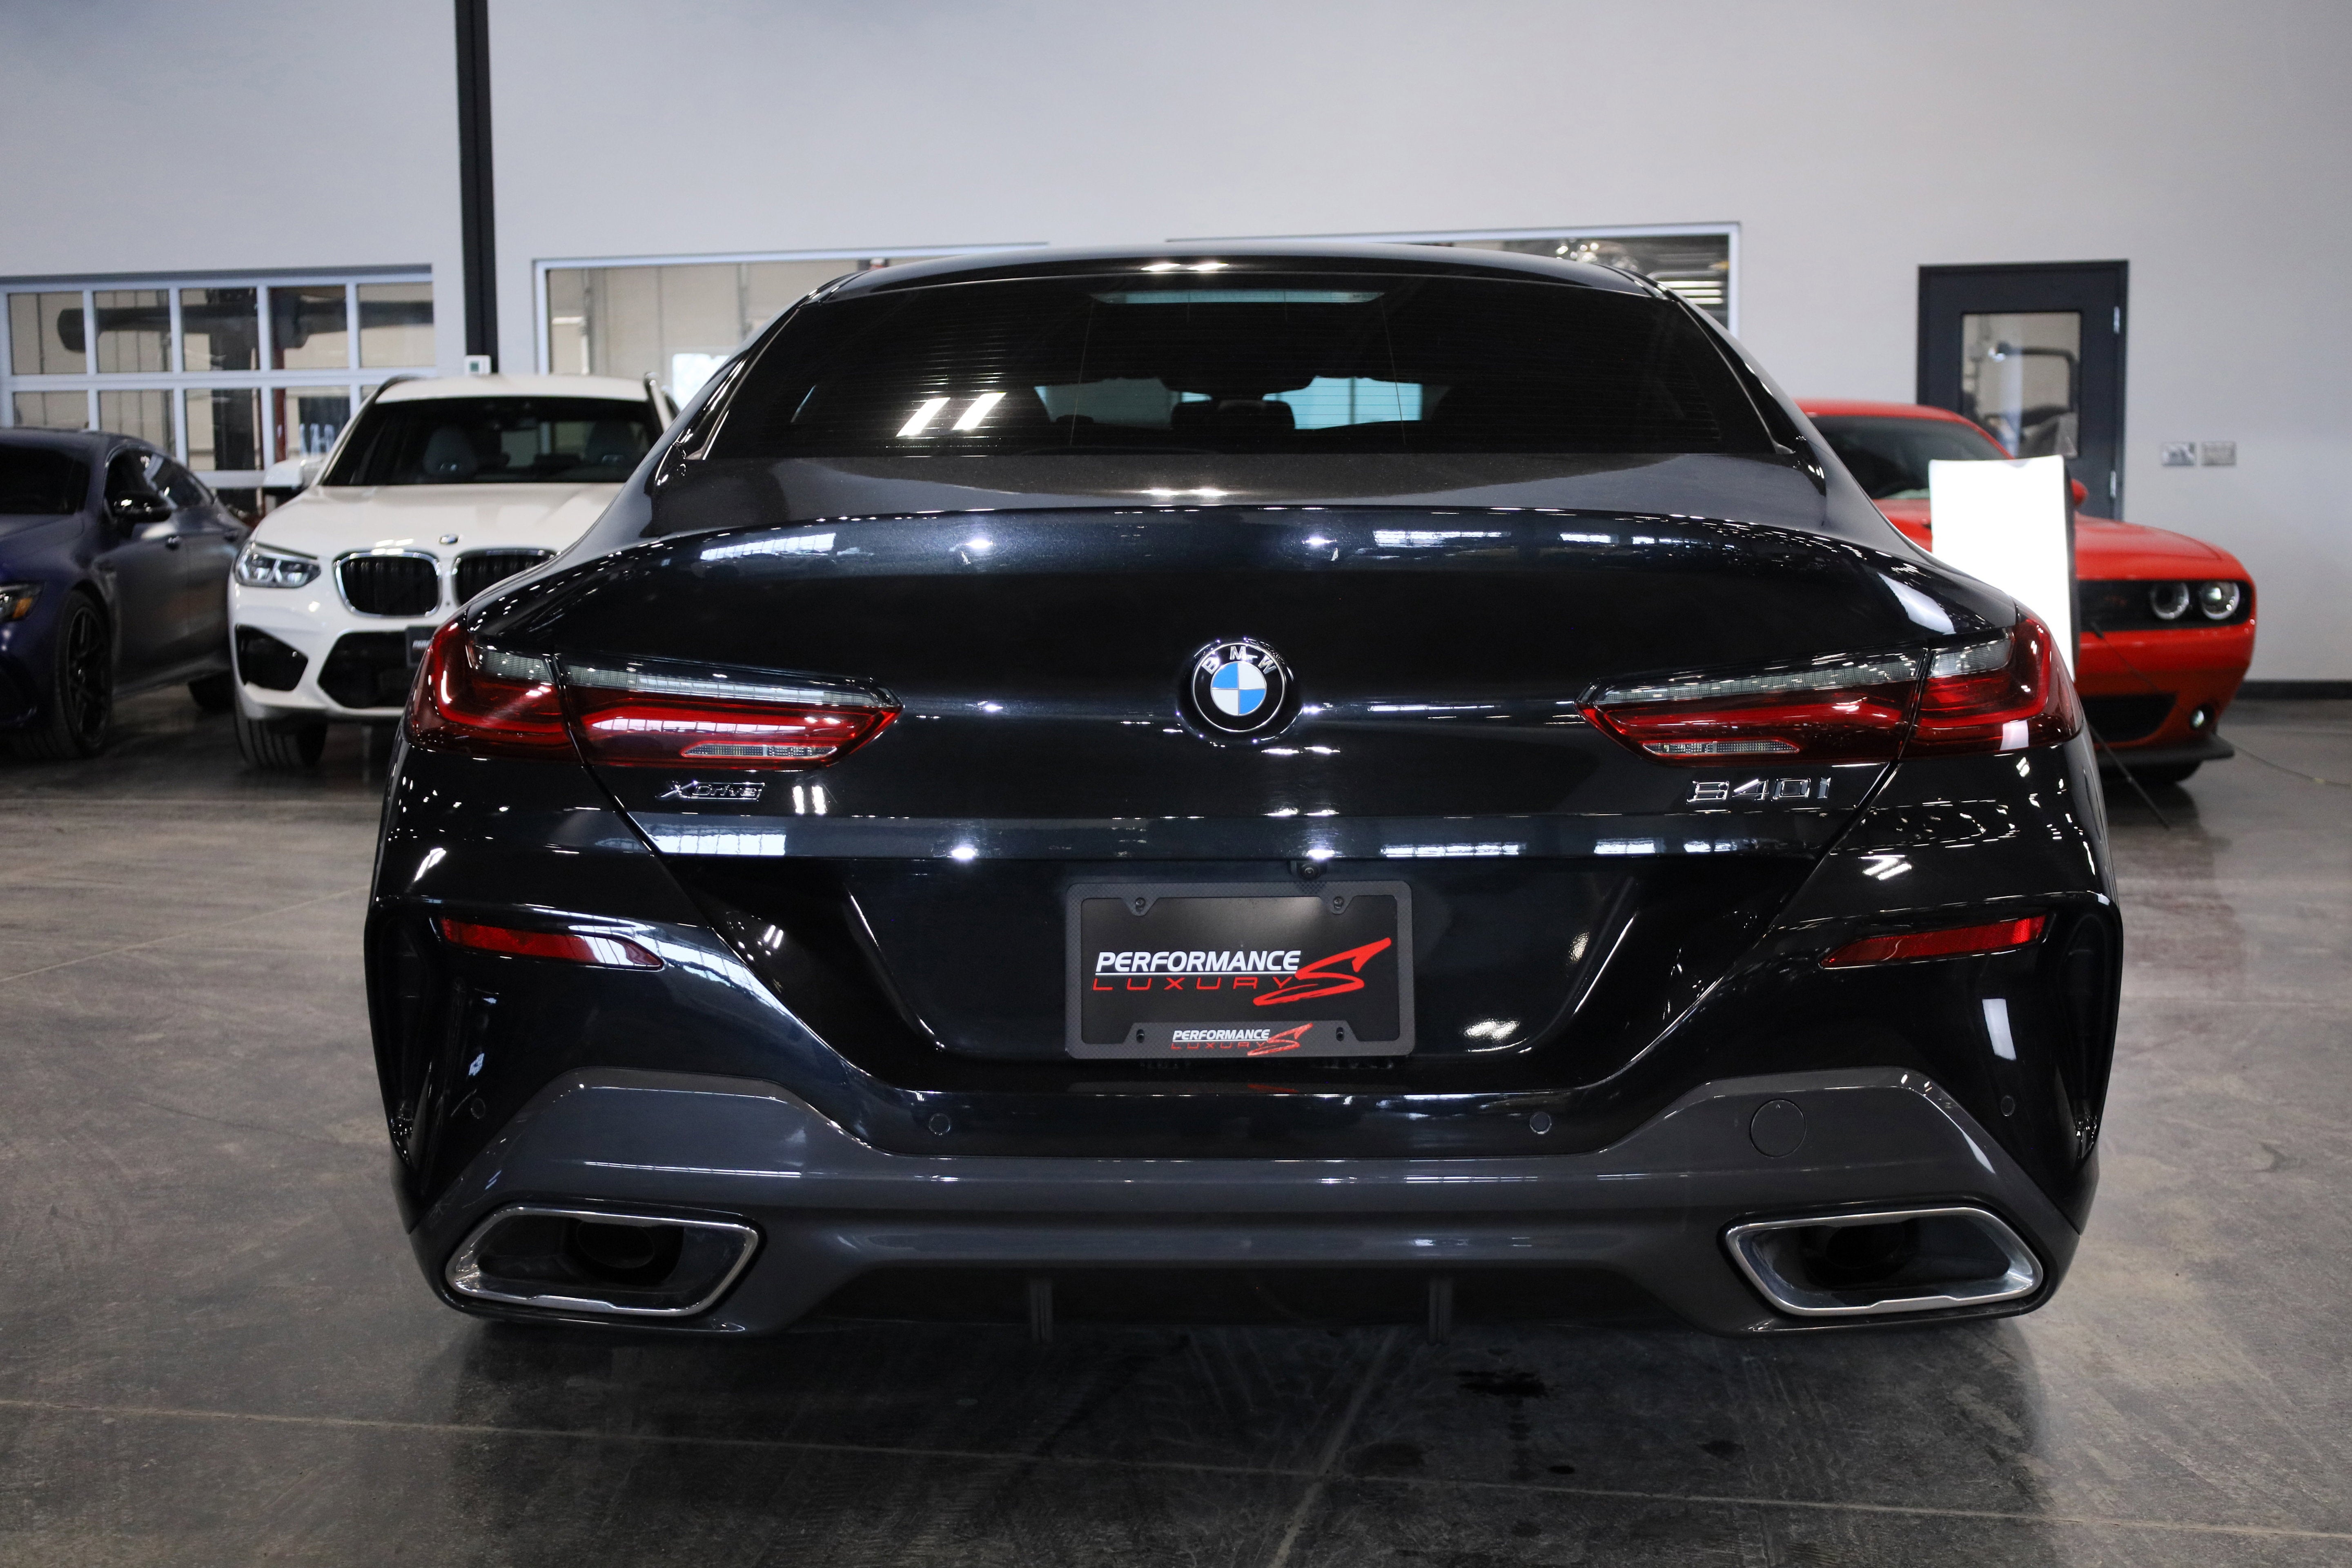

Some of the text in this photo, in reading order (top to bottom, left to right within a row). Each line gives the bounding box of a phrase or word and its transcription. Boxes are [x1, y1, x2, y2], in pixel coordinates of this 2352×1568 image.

[1201, 646, 1277, 675] BMW
[1095, 950, 1301, 972] PERFORMANCE
[1092, 976, 1293, 990] LUXURY
[1172, 1029, 1270, 1040] PERFORMANCE
[1170, 1041, 1266, 1050] LUXURY
